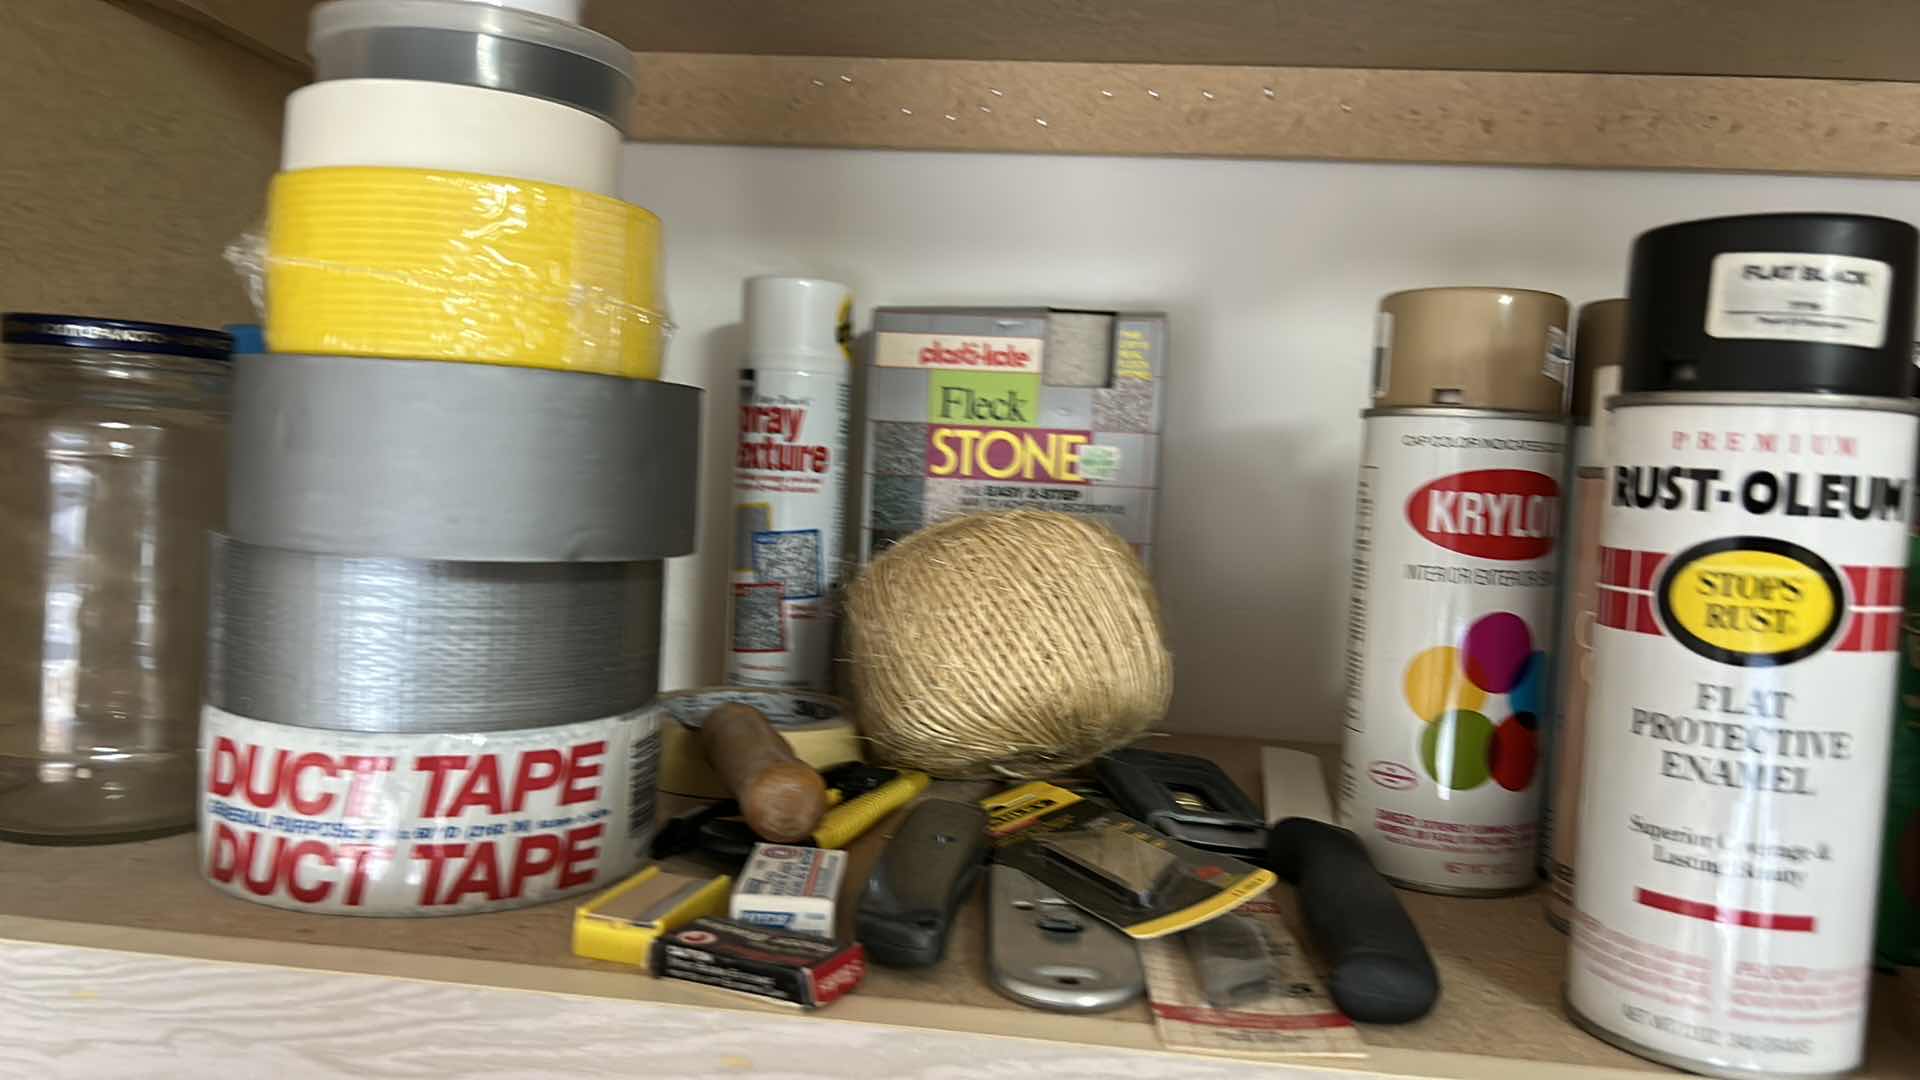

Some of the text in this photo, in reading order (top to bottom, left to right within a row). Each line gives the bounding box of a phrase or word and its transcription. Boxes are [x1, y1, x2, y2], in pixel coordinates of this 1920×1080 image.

[1742, 264, 1796, 281] FLAT
[939, 386, 1027, 423] Fleck
[929, 427, 1089, 481] STONE
[1671, 430, 1860, 457] PREMIUM
[1612, 465, 1907, 521] RUST-OLEUM
[1695, 570, 1804, 602] STOPS
[1697, 682, 1796, 720] FLAT
[1630, 707, 1853, 760] PROTECTIVE
[209, 735, 608, 819] DUCT TAPE
[1661, 748, 1817, 796] ENAMEL
[1627, 813, 1716, 848] Superior
[1717, 833, 1807, 862] Cverage
[210, 820, 396, 907] DUCT
[411, 822, 606, 907] TAPE
